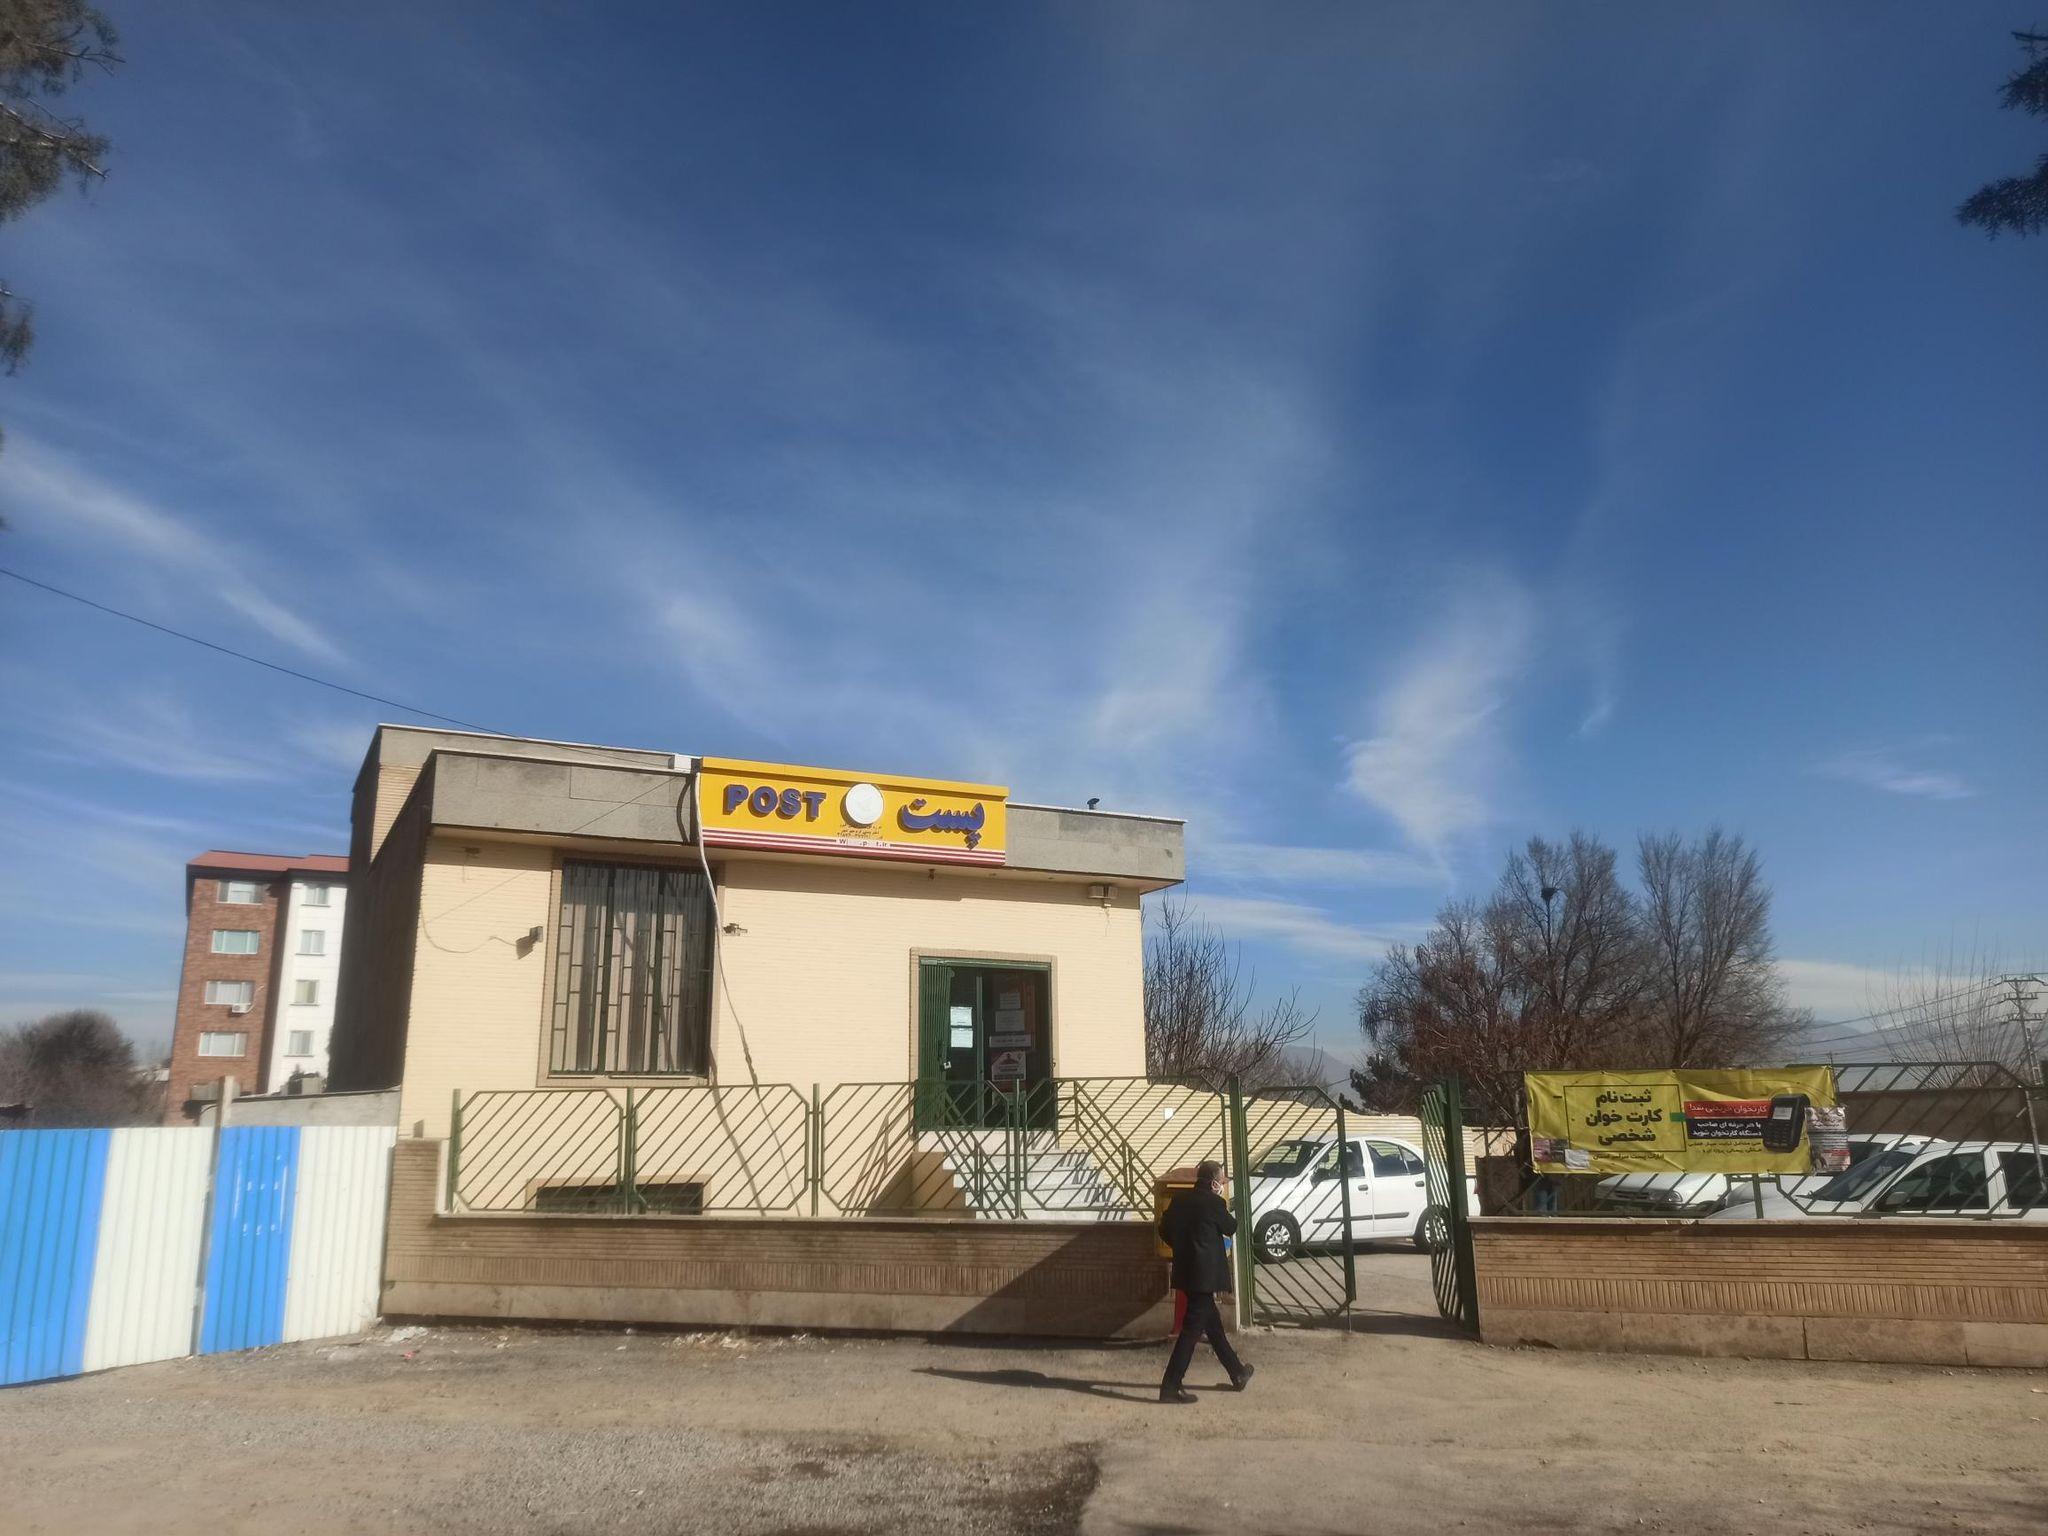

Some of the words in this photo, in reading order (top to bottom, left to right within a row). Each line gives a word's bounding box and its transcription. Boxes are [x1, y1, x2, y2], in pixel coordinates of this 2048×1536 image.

[723, 784, 826, 823] POST
[897, 798, 986, 851] پست
[1596, 1091, 1620, 1107] نام
[1620, 1089, 1651, 1107] ثبت
[1586, 1109, 1622, 1126] خوان
[1627, 1109, 1662, 1125] کارت
[1734, 1105, 1767, 1113] کارتخوان
[1598, 1127, 1656, 1145] شخصی
[1711, 1129, 1738, 1137] کارتخوان
